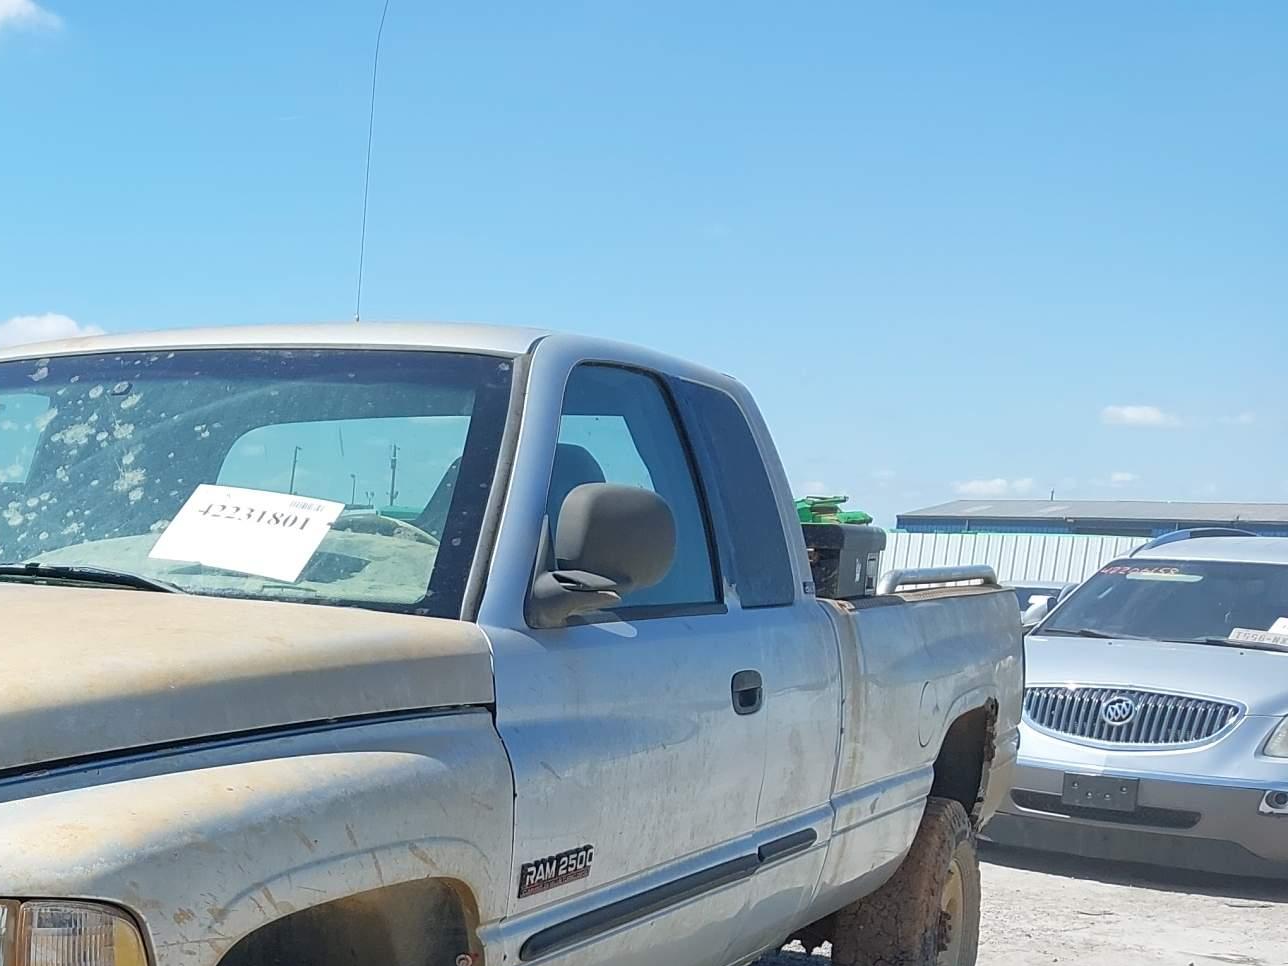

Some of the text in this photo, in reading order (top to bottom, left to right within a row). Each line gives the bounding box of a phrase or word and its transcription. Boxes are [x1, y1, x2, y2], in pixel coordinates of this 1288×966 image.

[198, 503, 311, 531] 42231801
[525, 859, 558, 886] RAM
[558, 848, 595, 876] 2500
